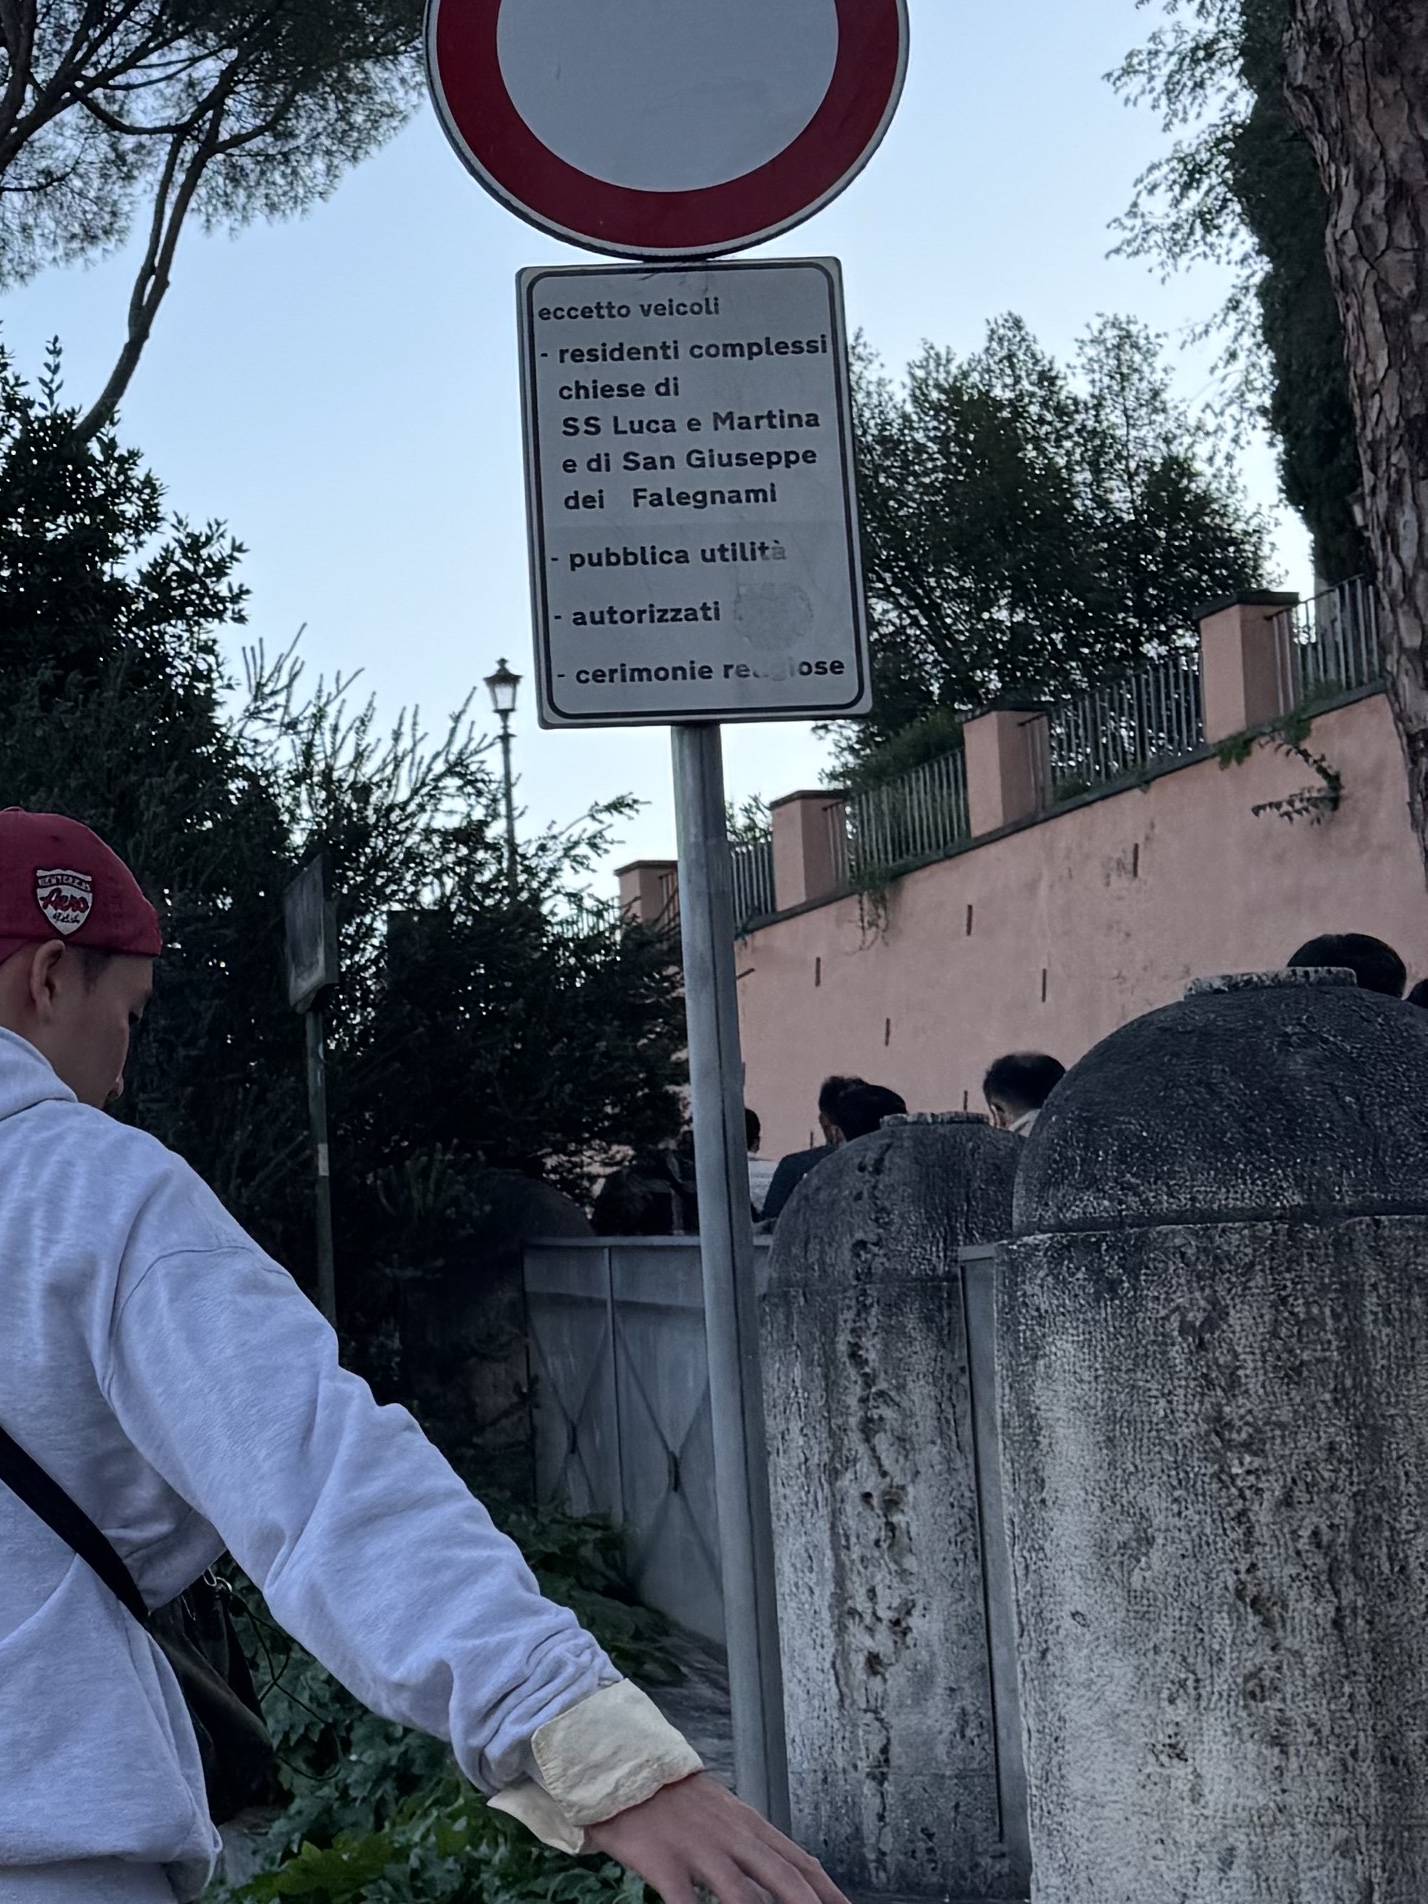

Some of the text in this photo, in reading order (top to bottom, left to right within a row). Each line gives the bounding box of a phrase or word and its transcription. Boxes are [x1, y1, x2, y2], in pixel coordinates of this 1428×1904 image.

[538, 296, 720, 321] eccetto veicoli
[558, 339, 679, 364] residenti
[689, 333, 828, 361] complessi
[558, 376, 680, 400] chiese di
[561, 408, 820, 437] SS Luca e Martina
[562, 448, 817, 474] e di San Giuseppe
[563, 482, 777, 510] dei Falegnami
[569, 545, 690, 572] pubblica
[700, 539, 787, 563] utilità
[572, 600, 720, 626] autorizzati
[575, 660, 714, 684] cerimonie
